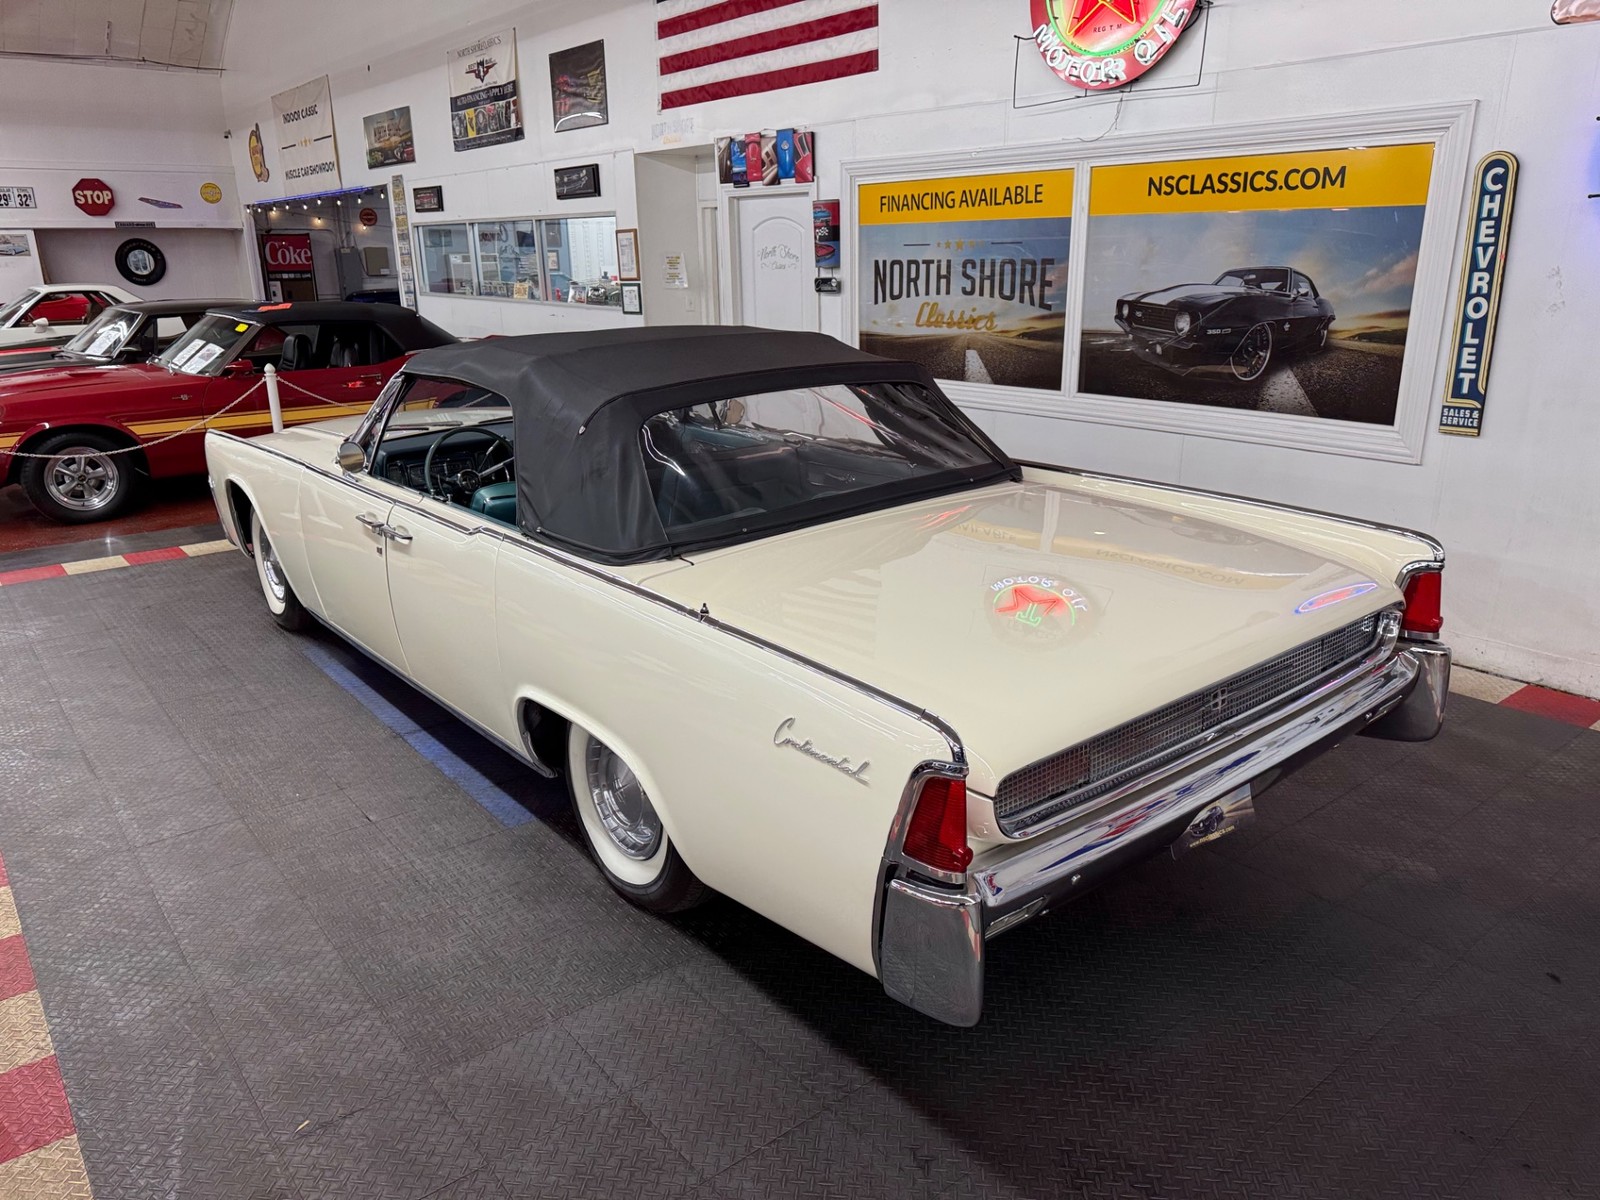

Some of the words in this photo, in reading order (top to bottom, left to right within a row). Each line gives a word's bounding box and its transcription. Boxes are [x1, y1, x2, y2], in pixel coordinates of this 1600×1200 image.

[1033, 23, 1126, 85] MOTOR
[1134, 8, 1188, 65] OIL
[301, 166, 309, 177] CAR
[1147, 165, 1347, 197] NSCLASSICS.COM
[74, 190, 112, 205] STOP
[879, 190, 955, 213] FINANCING
[958, 184, 1043, 208] AVAILABLE
[265, 240, 312, 265] Coke
[873, 258, 951, 305] NORTH
[961, 258, 1055, 311] SHORE
[1457, 167, 1505, 394] CHEVROLET
[915, 301, 998, 331] Classics
[1441, 416, 1478, 427] SERVICE
[1443, 408, 1470, 418] SALES
[1472, 410, 1479, 419] &
[773, 717, 871, 782] Continental
